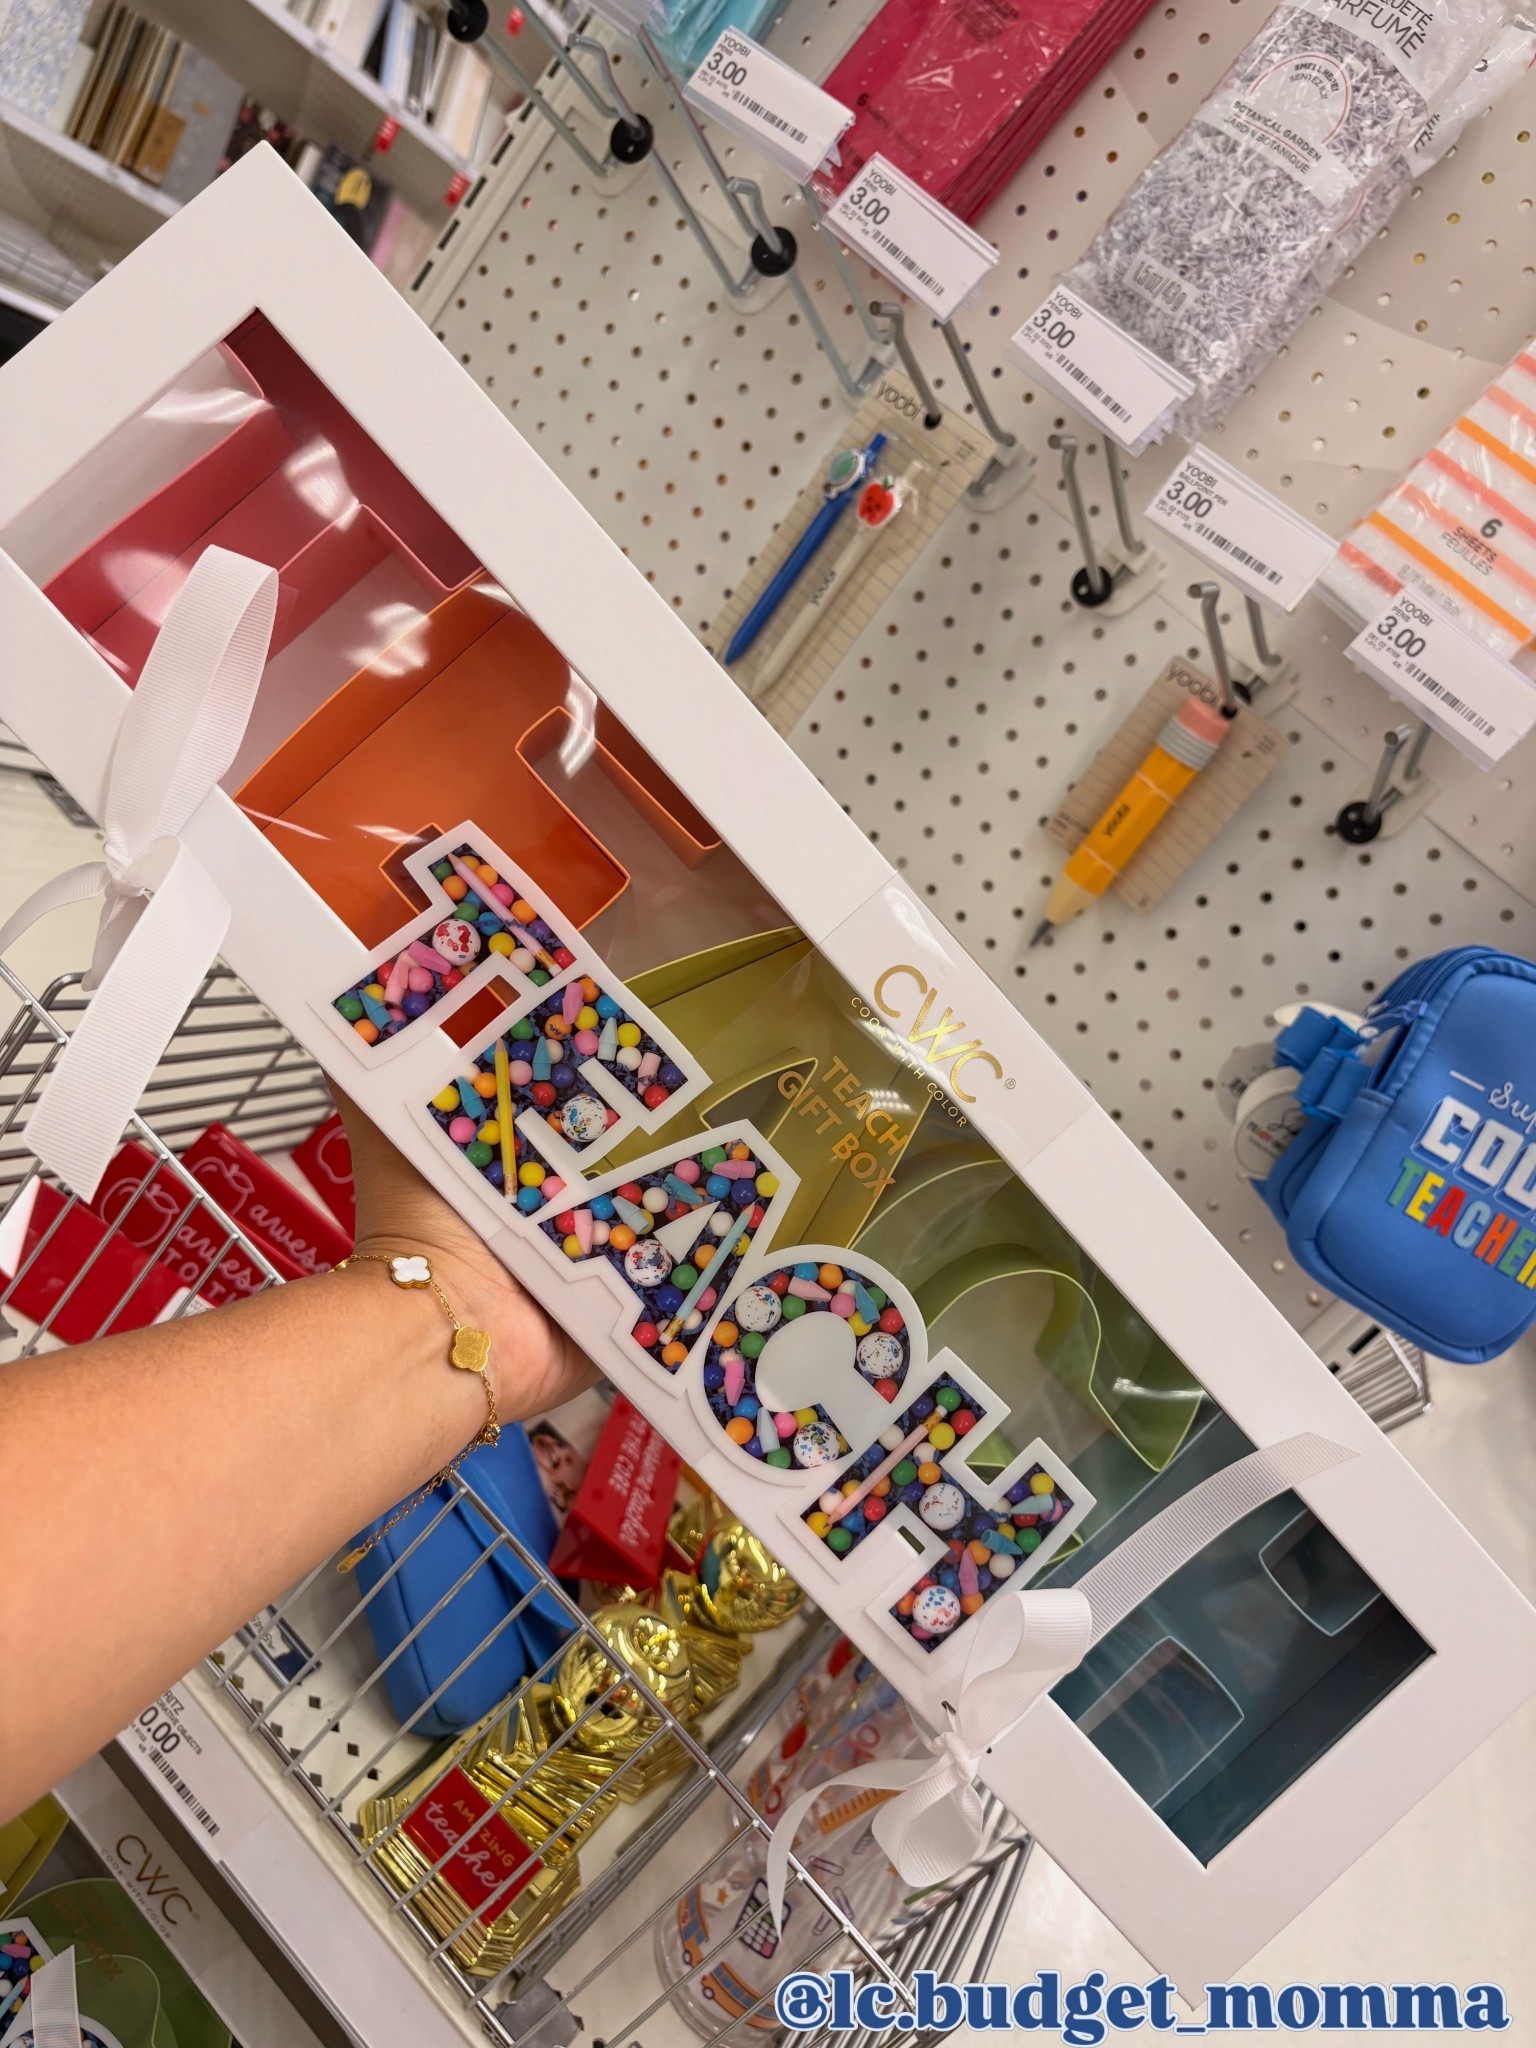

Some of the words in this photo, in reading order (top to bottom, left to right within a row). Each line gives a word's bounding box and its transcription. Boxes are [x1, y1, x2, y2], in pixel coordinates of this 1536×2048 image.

[1324, 0, 1427, 58] RFUMÉ
[1380, 0, 1434, 31] UETÉ
[722, 34, 752, 58] YOOBI
[707, 52, 747, 86] 3.00
[1232, 100, 1284, 133] BOTANICAL
[1283, 129, 1322, 161] GARDEN
[1256, 133, 1310, 174] BOTANIQUE
[869, 169, 898, 197] YOOBI
[850, 186, 890, 225] 3.00
[1053, 291, 1084, 320] YOOBI
[1032, 308, 1076, 349] 3.00
[875, 381, 924, 421] yoobi
[1185, 462, 1218, 488] YOOBI
[1166, 480, 1213, 518] 3.00
[1453, 526, 1498, 563] SHEETS
[1480, 518, 1503, 539] 6
[1439, 532, 1494, 576] FEUILLES
[1399, 596, 1434, 627] YOOBI
[1377, 615, 1426, 657] 3.00
[873, 964, 1004, 1104] CWC
[851, 997, 888, 1039] COOK
[891, 1042, 926, 1080] WITH
[927, 1082, 968, 1128] COLOR
[821, 1055, 910, 1156] TEACH
[777, 1070, 843, 1136] GIFT
[831, 1132, 896, 1200] BOX
[161, 1247, 199, 1282] TO
[608, 1454, 635, 1498] CORE
[139, 1706, 180, 1754] 0.00
[176, 1724, 203, 1755] OBJECTS
[425, 1801, 505, 1889] teache
[116, 1834, 193, 1925] CWC
